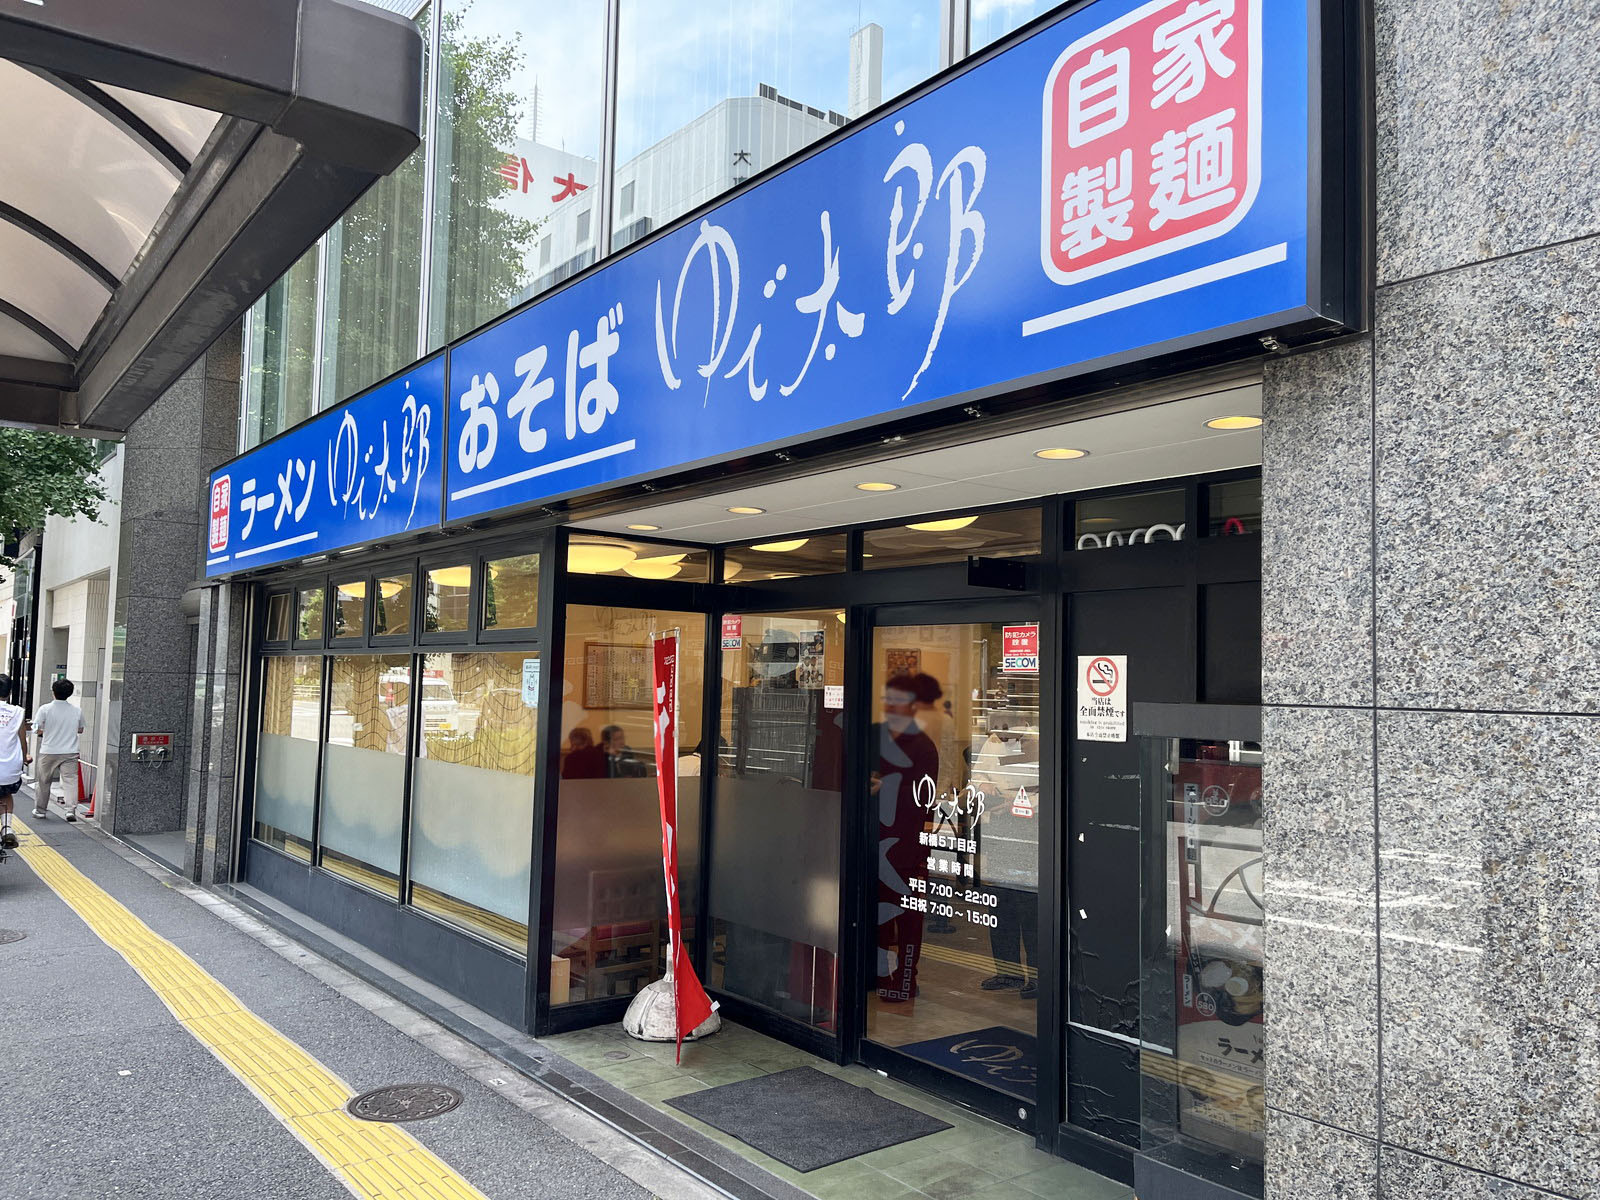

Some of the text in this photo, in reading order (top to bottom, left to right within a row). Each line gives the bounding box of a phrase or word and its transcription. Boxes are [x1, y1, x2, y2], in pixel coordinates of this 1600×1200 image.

[1067, 0, 1238, 149] 自家
[1060, 107, 1238, 260] 製麺
[458, 121, 987, 474] おそば ゆで太郎
[240, 381, 431, 541] ラーメン ゆで太郎
[1005, 657, 1036, 668] SECOM
[1079, 705, 1126, 718] 全面禁煙です
[1091, 697, 1112, 706] 当店は
[912, 773, 985, 831] ゆで太郎
[918, 831, 977, 855] 新橋5丁目店
[926, 856, 974, 878] 営業時間
[908, 877, 926, 894] 平日
[900, 894, 927, 914] 土日祝
